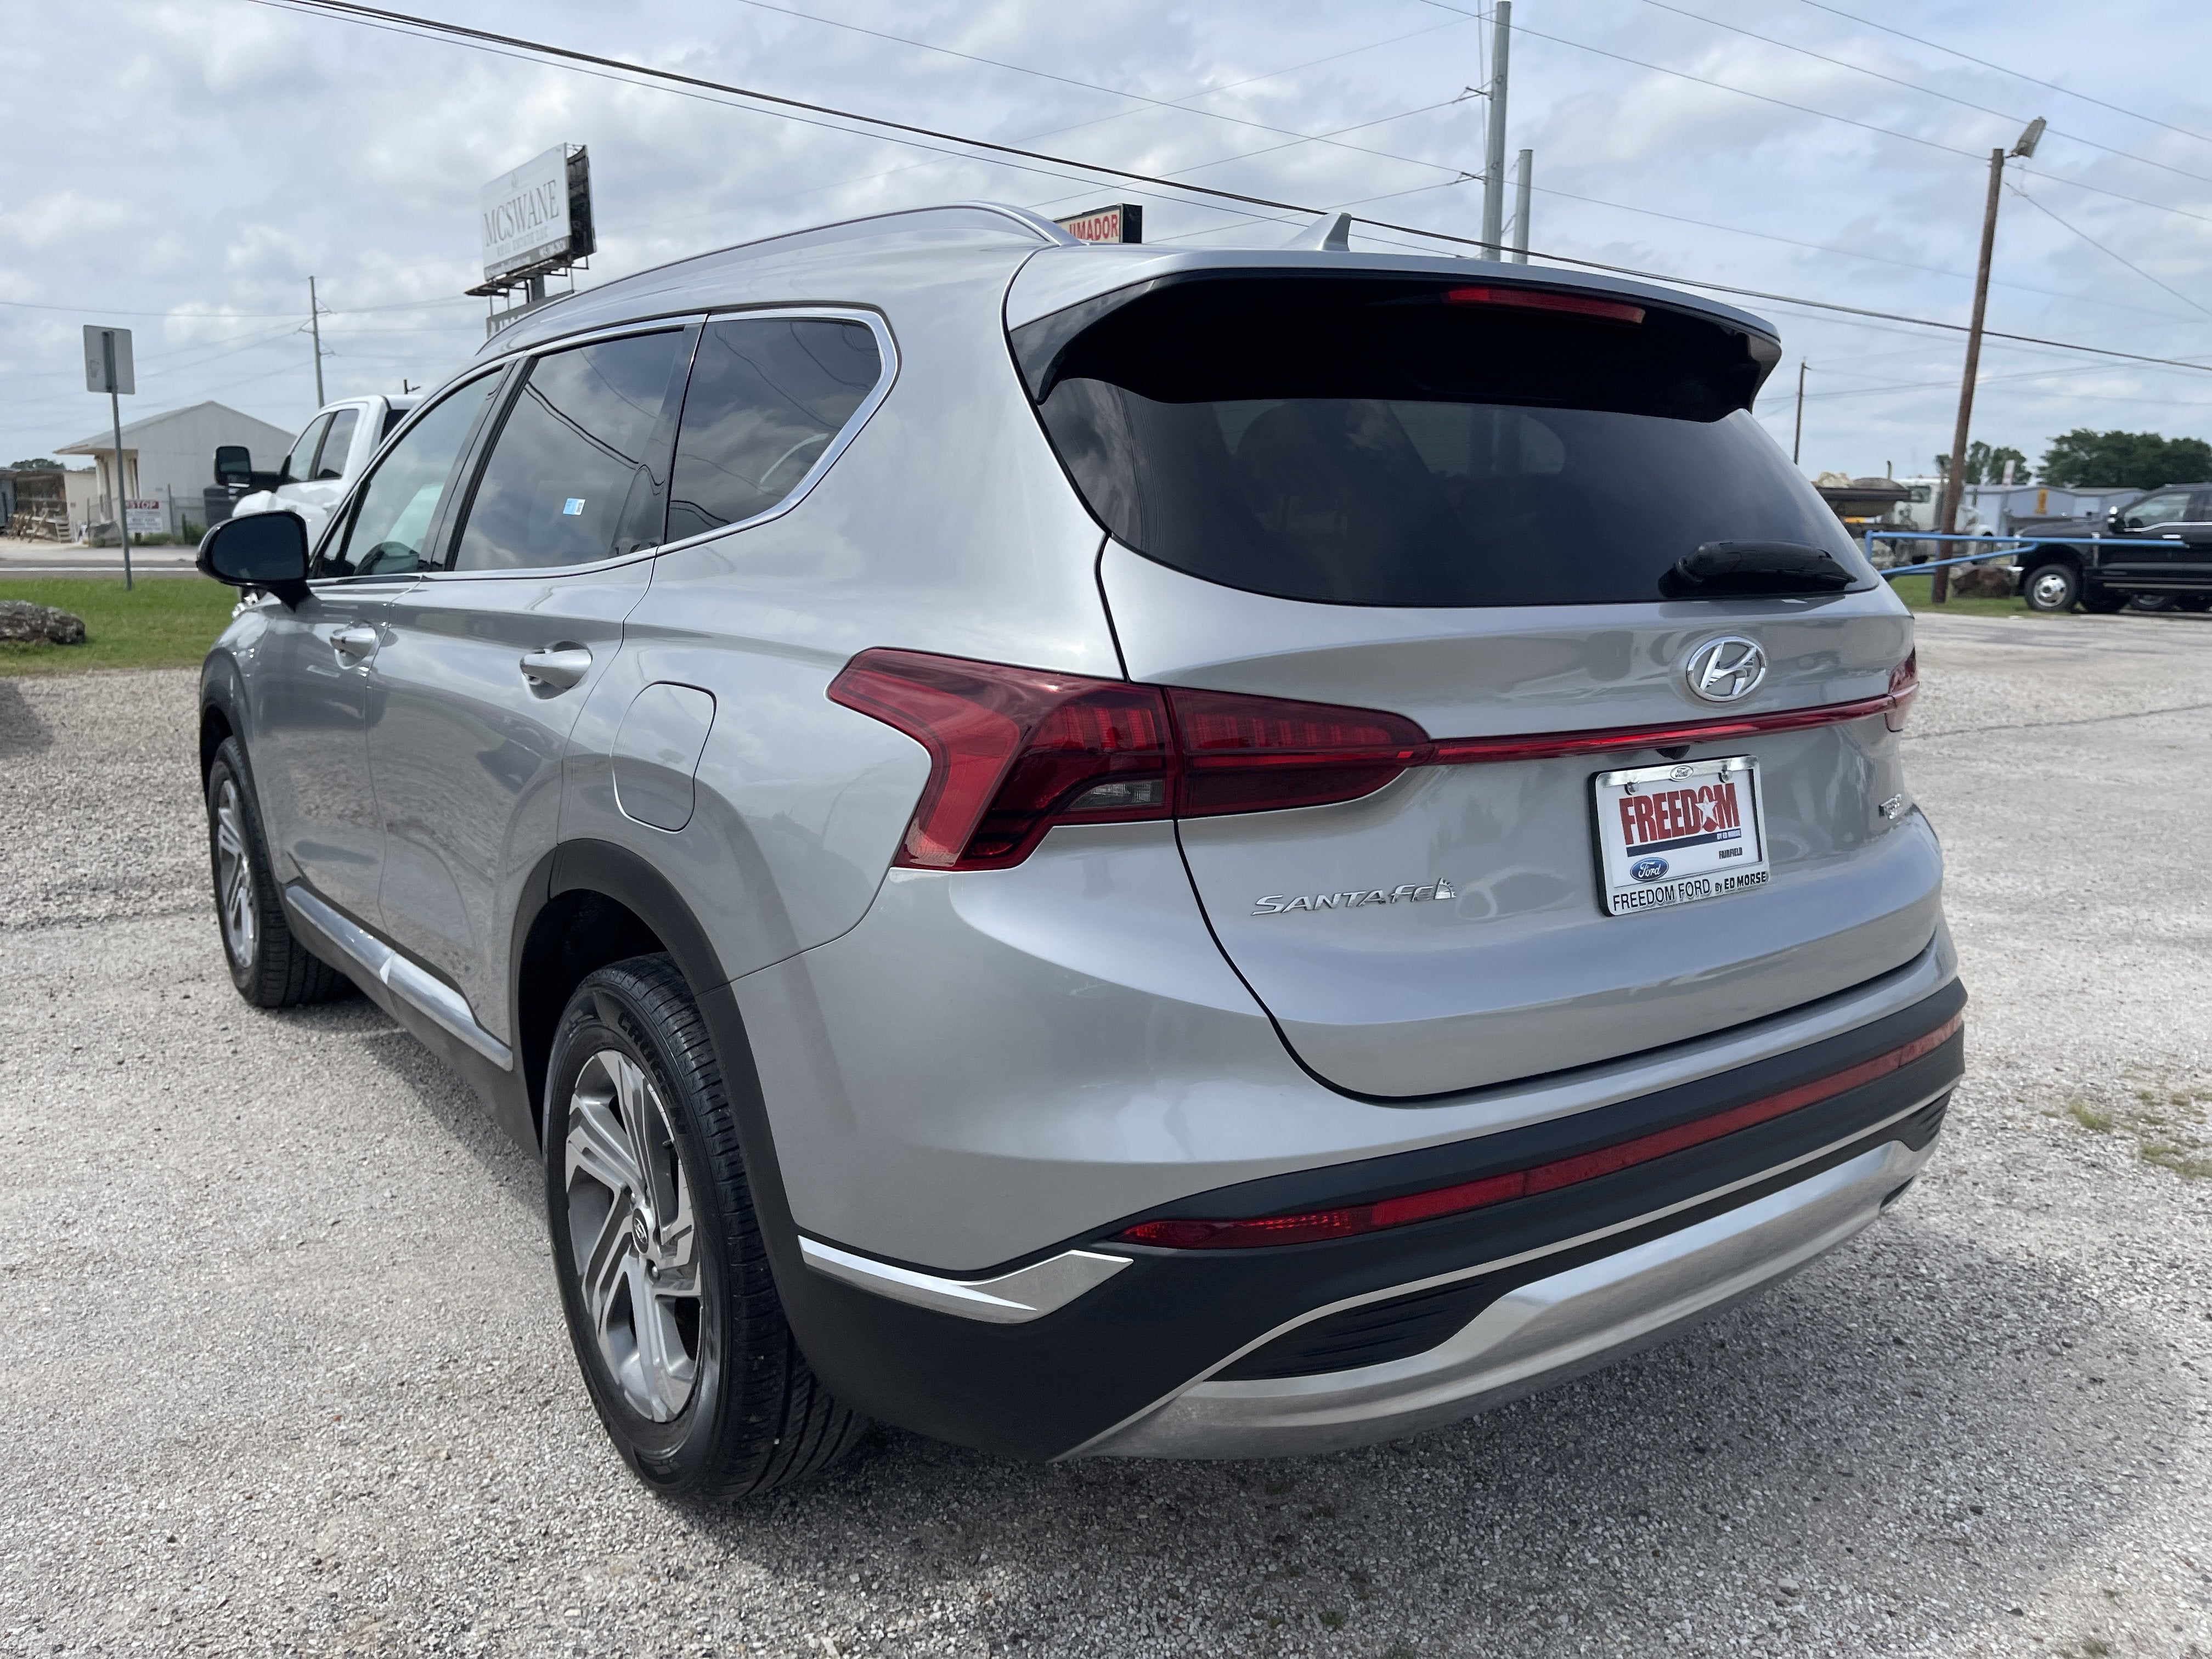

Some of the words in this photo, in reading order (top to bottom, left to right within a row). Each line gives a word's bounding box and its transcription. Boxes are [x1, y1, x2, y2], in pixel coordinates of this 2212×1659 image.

[484, 179, 559, 247] MCSWANE
[1619, 782, 1740, 845] FREEDOM
[1251, 890, 1386, 916] SANTA
[1613, 885, 1675, 911] FREEDOM
[1678, 878, 1711, 899] FORD
[1724, 877, 1736, 890] ED
[1737, 871, 1767, 887] MORSE
